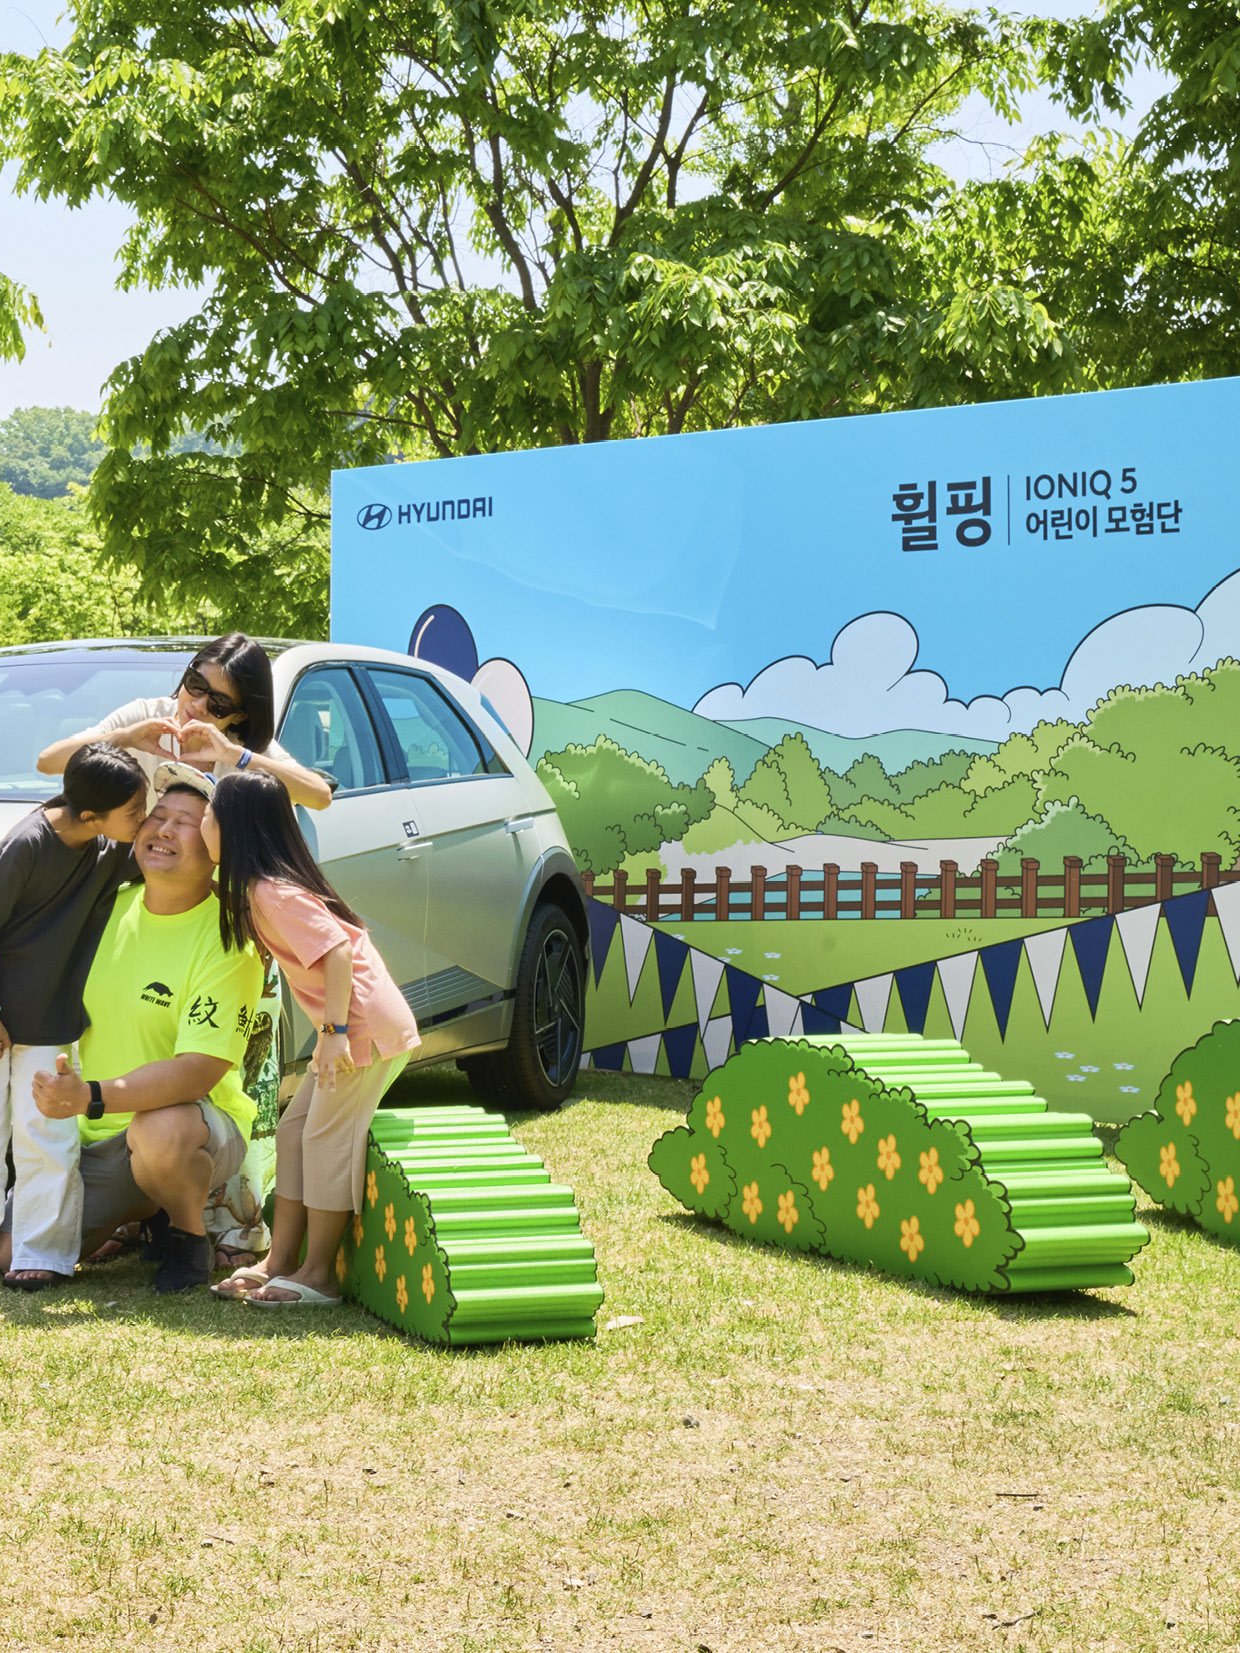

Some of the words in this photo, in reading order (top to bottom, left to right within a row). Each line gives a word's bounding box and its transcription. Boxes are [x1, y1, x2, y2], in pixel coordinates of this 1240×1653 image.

[1025, 469, 1111, 501] IONIQ
[1120, 467, 1138, 495] 5
[398, 496, 493, 525] HYUNDAI
[891, 476, 991, 552] 휠핑
[1025, 505, 1098, 541] 어린이
[1104, 500, 1183, 536] 모험단
[140, 993, 156, 1004] WHITE
[154, 998, 172, 1008] WAVE
